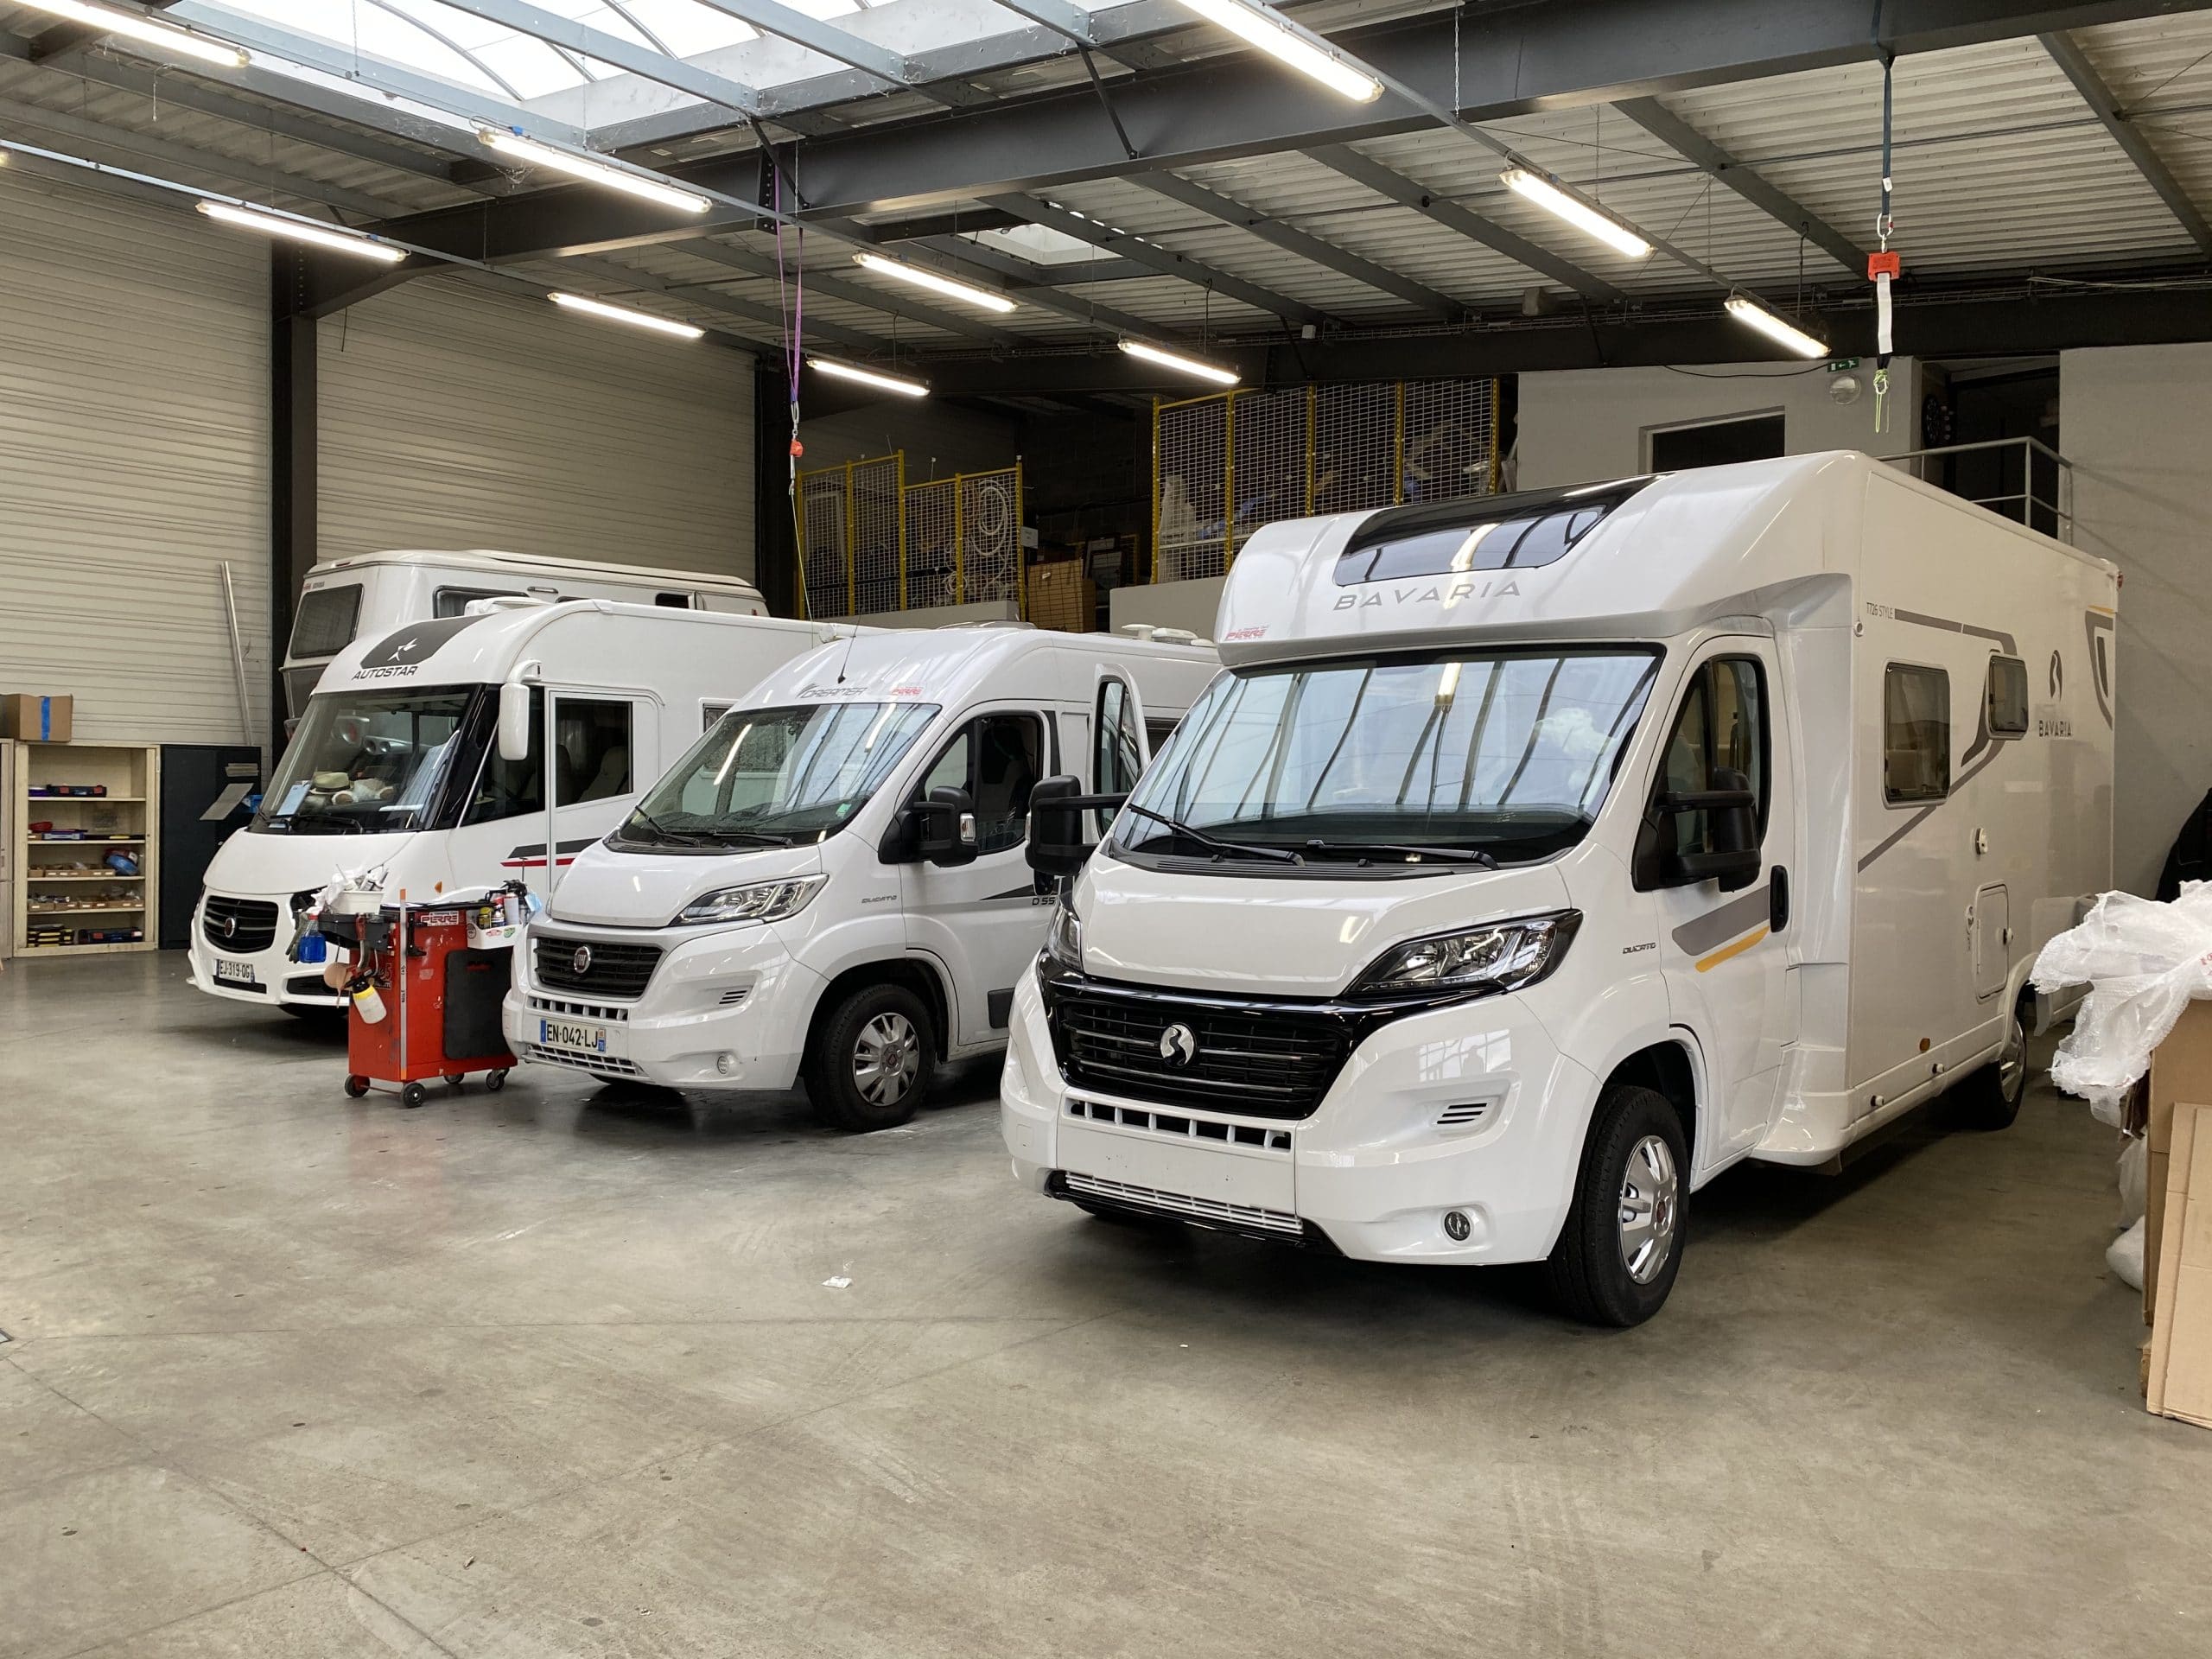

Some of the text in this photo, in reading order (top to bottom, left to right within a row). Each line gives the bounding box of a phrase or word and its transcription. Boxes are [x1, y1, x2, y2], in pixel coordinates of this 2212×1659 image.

[1332, 580, 1521, 611] BAVARIA
[352, 666, 418, 680] AUTOSTAR
[2039, 720, 2072, 737] BAVARIA
[422, 915, 458, 924] PIERRE
[1623, 942, 1656, 954] DUCATO
[546, 1023, 599, 1049] EN-042-LJ
